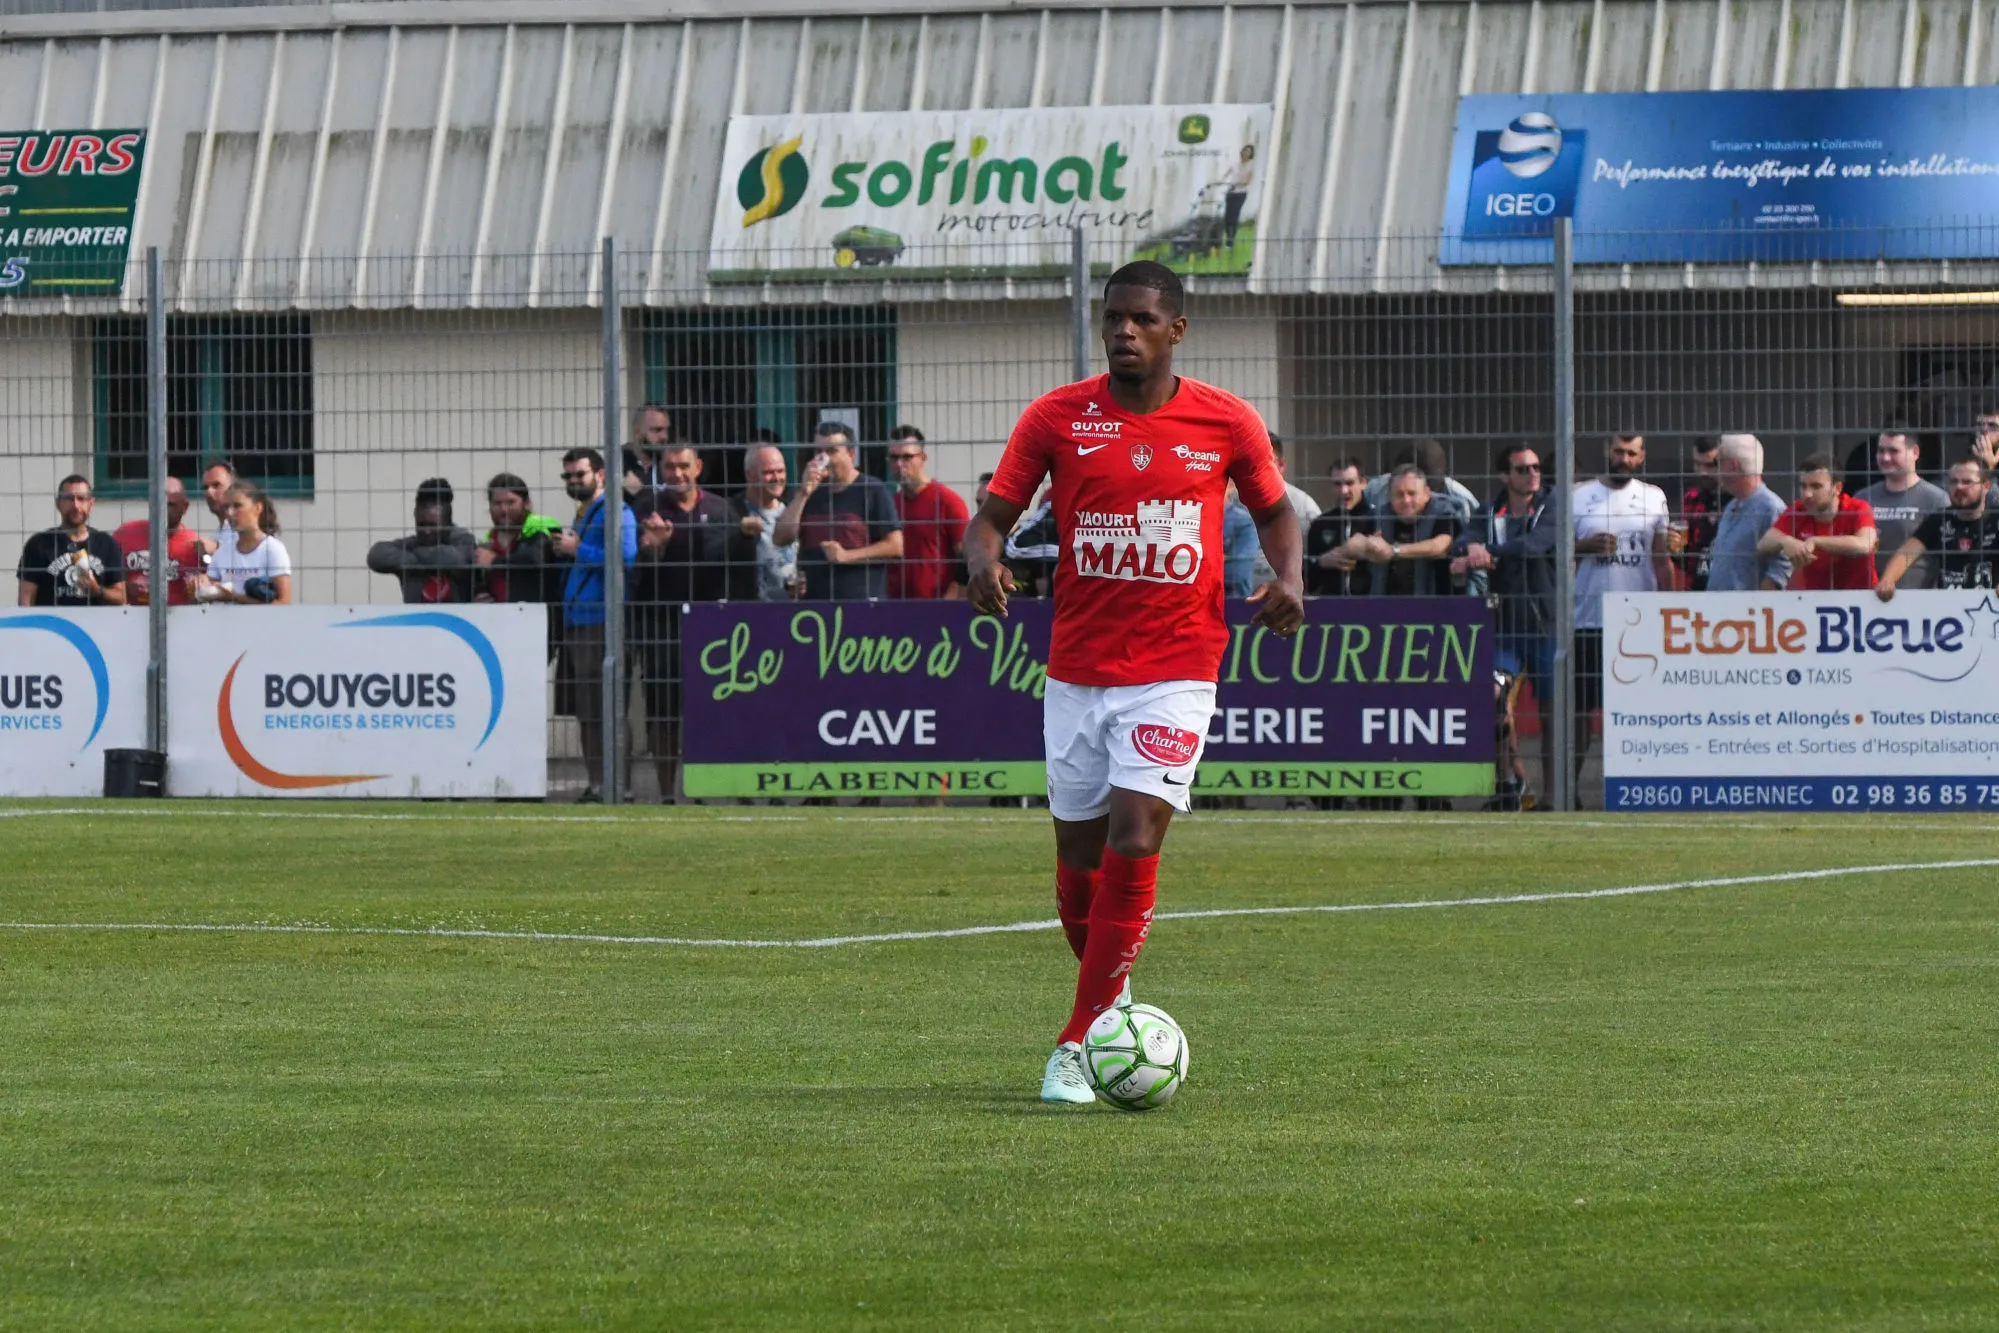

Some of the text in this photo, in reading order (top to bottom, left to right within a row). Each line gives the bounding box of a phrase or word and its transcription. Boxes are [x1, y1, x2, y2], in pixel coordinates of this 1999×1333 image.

[821, 135, 1129, 208] sofimat
[1593, 157, 1707, 190] Performance
[1711, 159, 1810, 188] énergétique
[1813, 155, 1836, 178] de
[1841, 163, 1872, 178] vos
[1485, 193, 1556, 216] IGEO
[937, 200, 1154, 233] motoculture
[4, 228, 20, 247] A
[22, 226, 129, 246] EMPORTER
[1071, 421, 1124, 432] GUYOT
[1072, 432, 1121, 440] environnement
[1171, 444, 1220, 463] Oceania
[1075, 511, 1135, 528] YAOURT
[1081, 541, 1199, 582] MALO
[1659, 605, 1964, 655] Etoile Bleue
[700, 621, 784, 701] Le
[790, 605, 922, 681] Verre
[926, 625, 962, 679] à
[1223, 623, 1484, 684] ICURIEN
[1662, 669, 1783, 685] AMBULANCES
[1806, 668, 1853, 685] TAXIS
[264, 672, 457, 709] BOUYGUES
[264, 714, 457, 730] ENERGIES & SERVICES
[817, 708, 938, 746] CAVE
[1361, 707, 1467, 745] FINE
[1611, 711, 1703, 729] Transports
[1706, 711, 1751, 726] Assis
[1755, 711, 1771, 726] et
[1776, 709, 1851, 729] Allongés
[1870, 709, 1926, 725] Toutes
[1141, 728, 1196, 757] Charnel
[1621, 739, 1689, 758] Dialyses
[1708, 738, 1771, 755] Entrées
[1777, 740, 1793, 754] et
[1799, 738, 1857, 754] Sorties
[756, 770, 1008, 791] PLABENNEC
[1619, 784, 1999, 806] 29860 PLABENNEC 02 98 36 85 75
